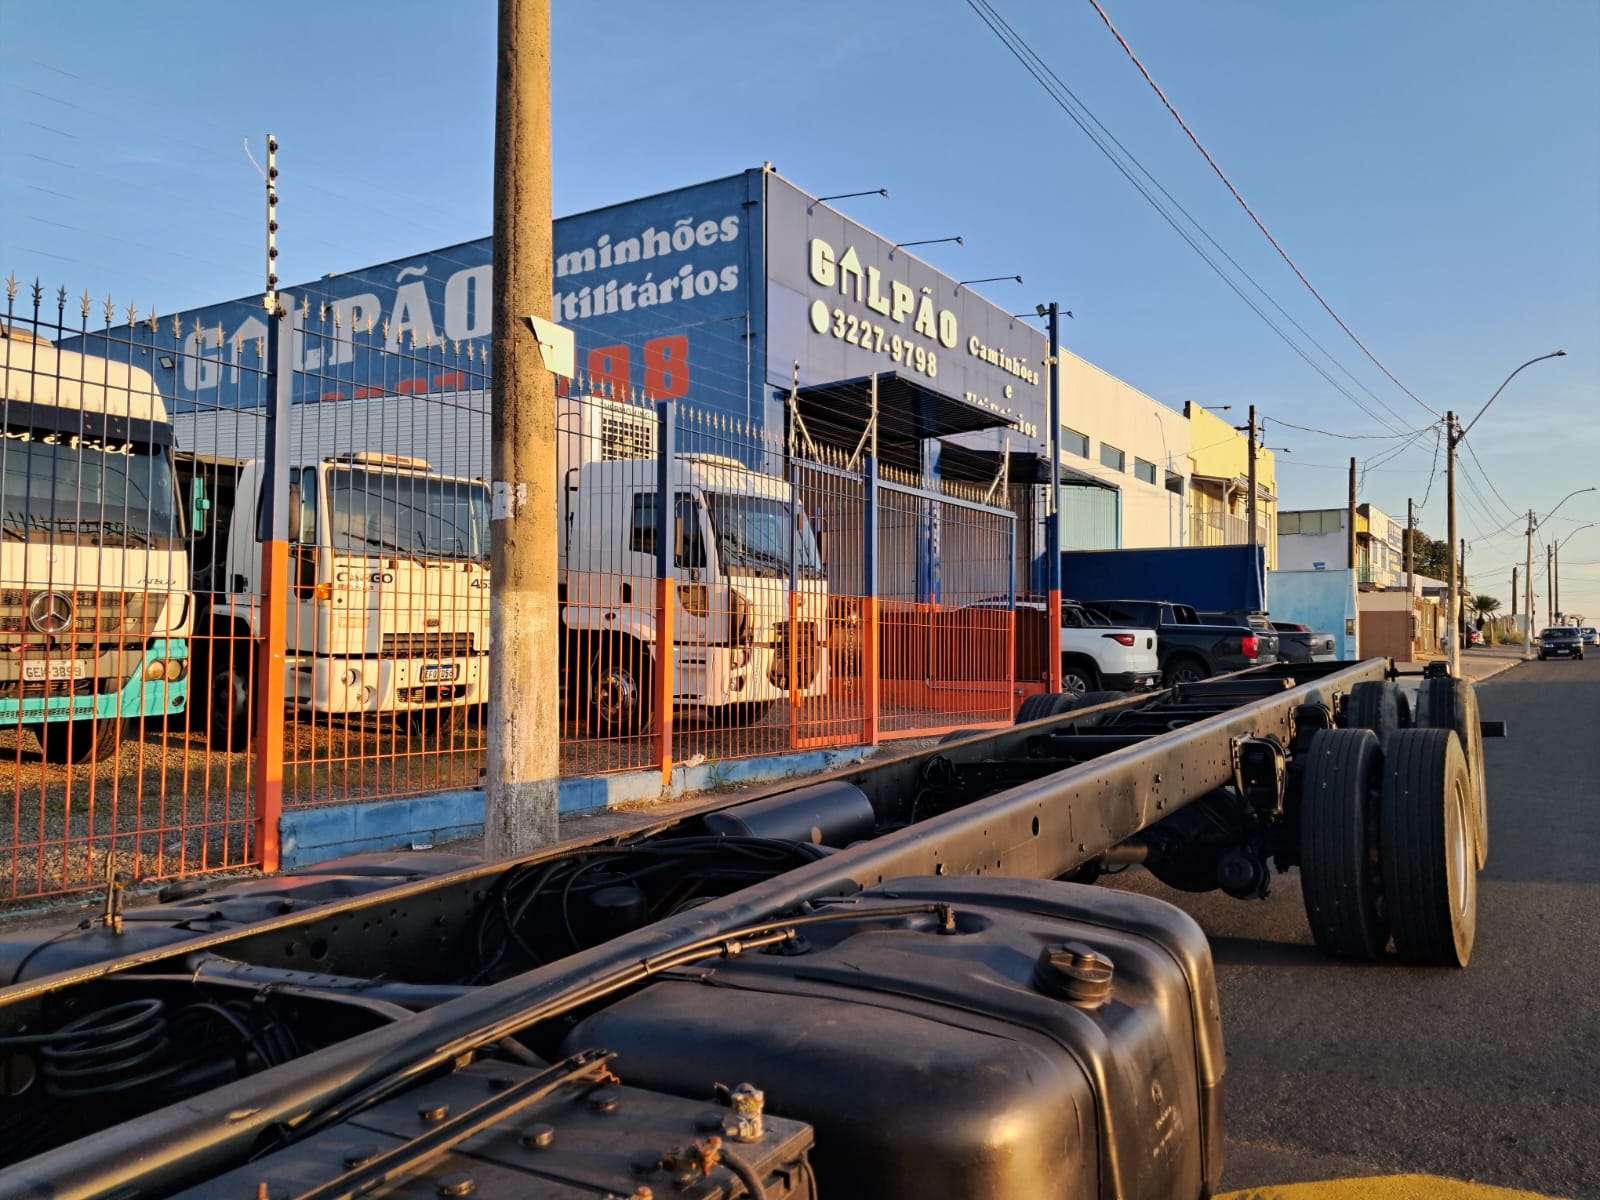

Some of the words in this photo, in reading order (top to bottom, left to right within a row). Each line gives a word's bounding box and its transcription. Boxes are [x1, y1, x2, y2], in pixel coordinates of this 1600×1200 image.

[553, 216, 739, 278] minhões
[810, 238, 958, 349] GALPÃO
[832, 308, 937, 378] 3227-9798
[968, 335, 1039, 385] Caminhões
[1004, 384, 1013, 399] e
